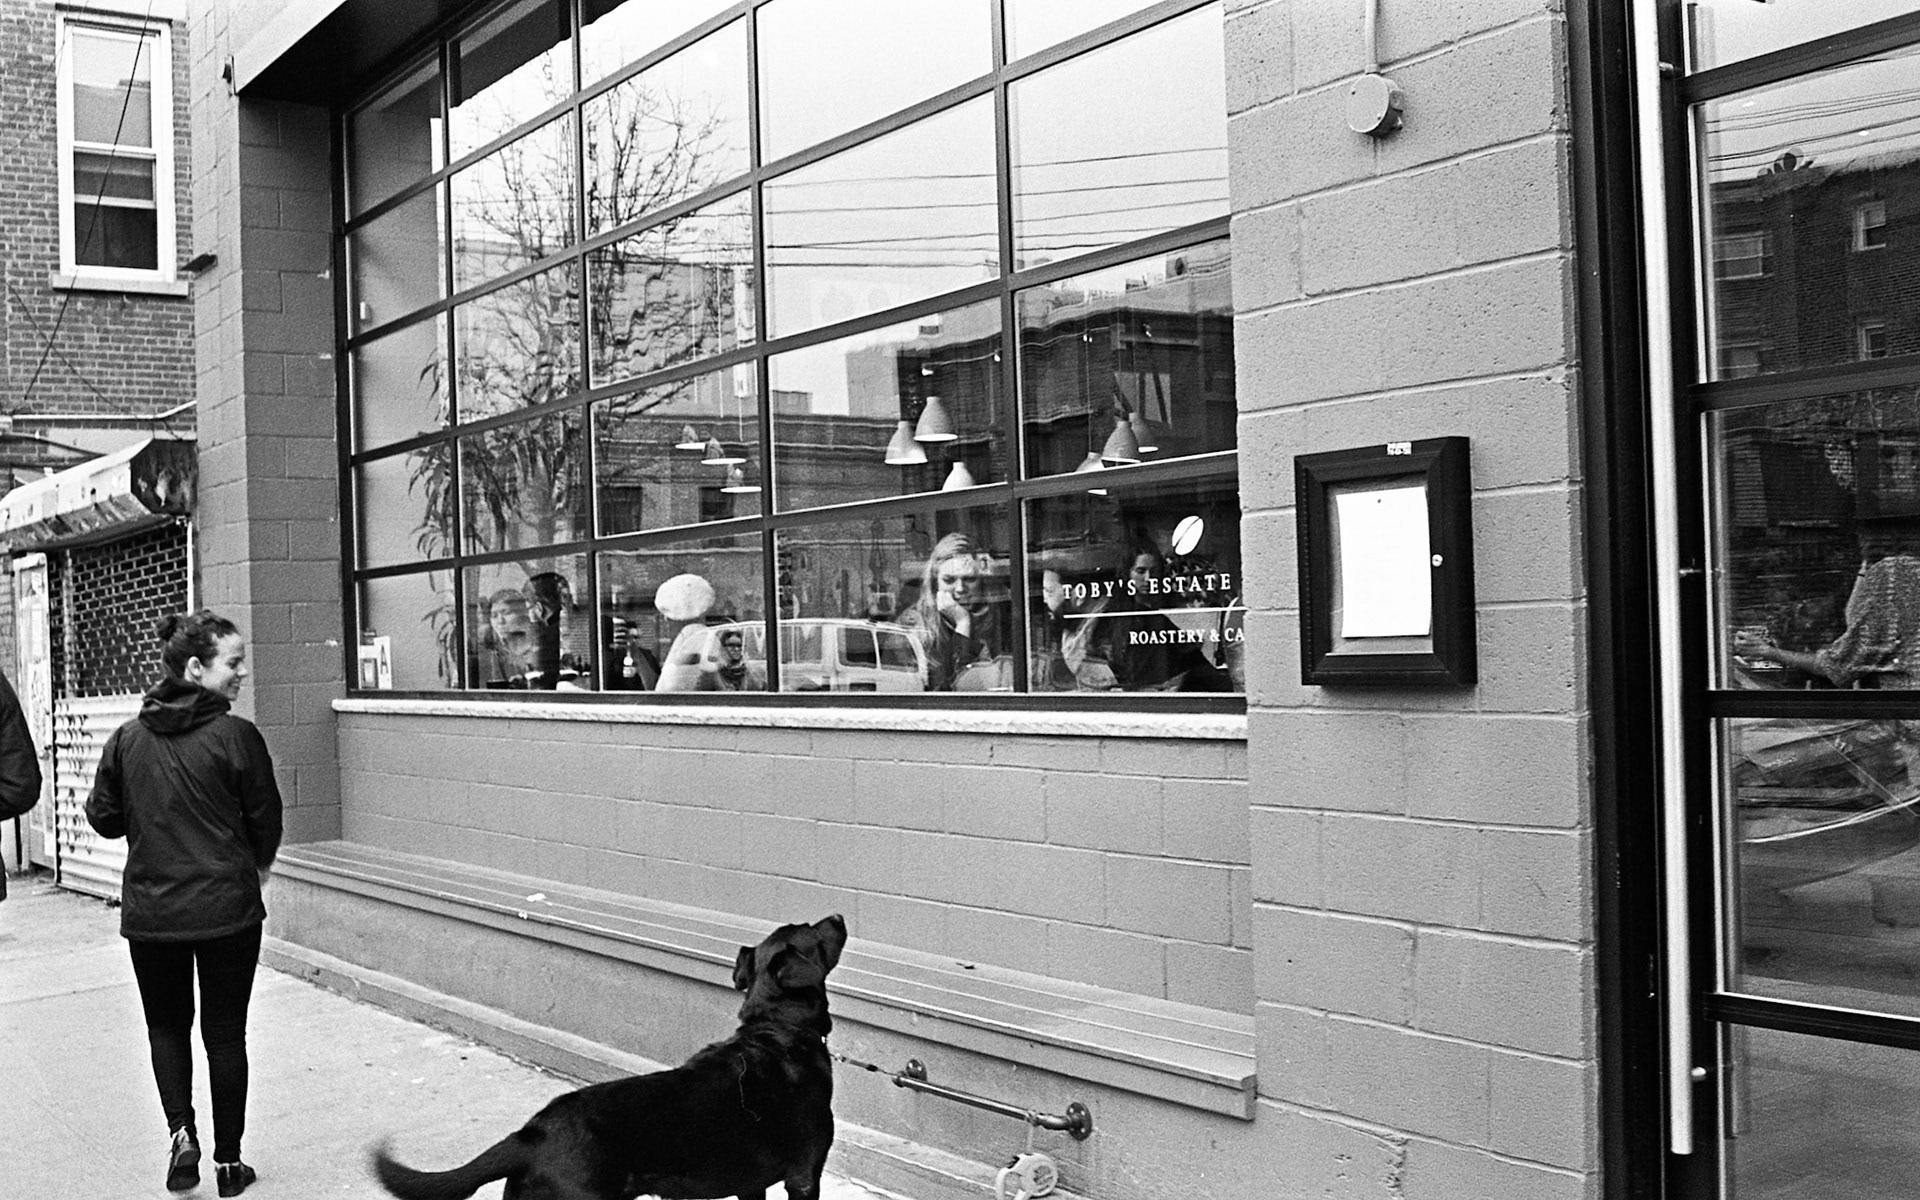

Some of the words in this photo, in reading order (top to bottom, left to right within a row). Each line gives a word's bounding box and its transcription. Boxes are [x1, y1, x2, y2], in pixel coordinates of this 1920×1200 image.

[1062, 579, 1137, 600] TOBY'S
[1149, 573, 1231, 595] ESTATE
[1129, 629, 1206, 645] ROASTERY
[1209, 628, 1221, 643] &
[380, 644, 389, 675] A
